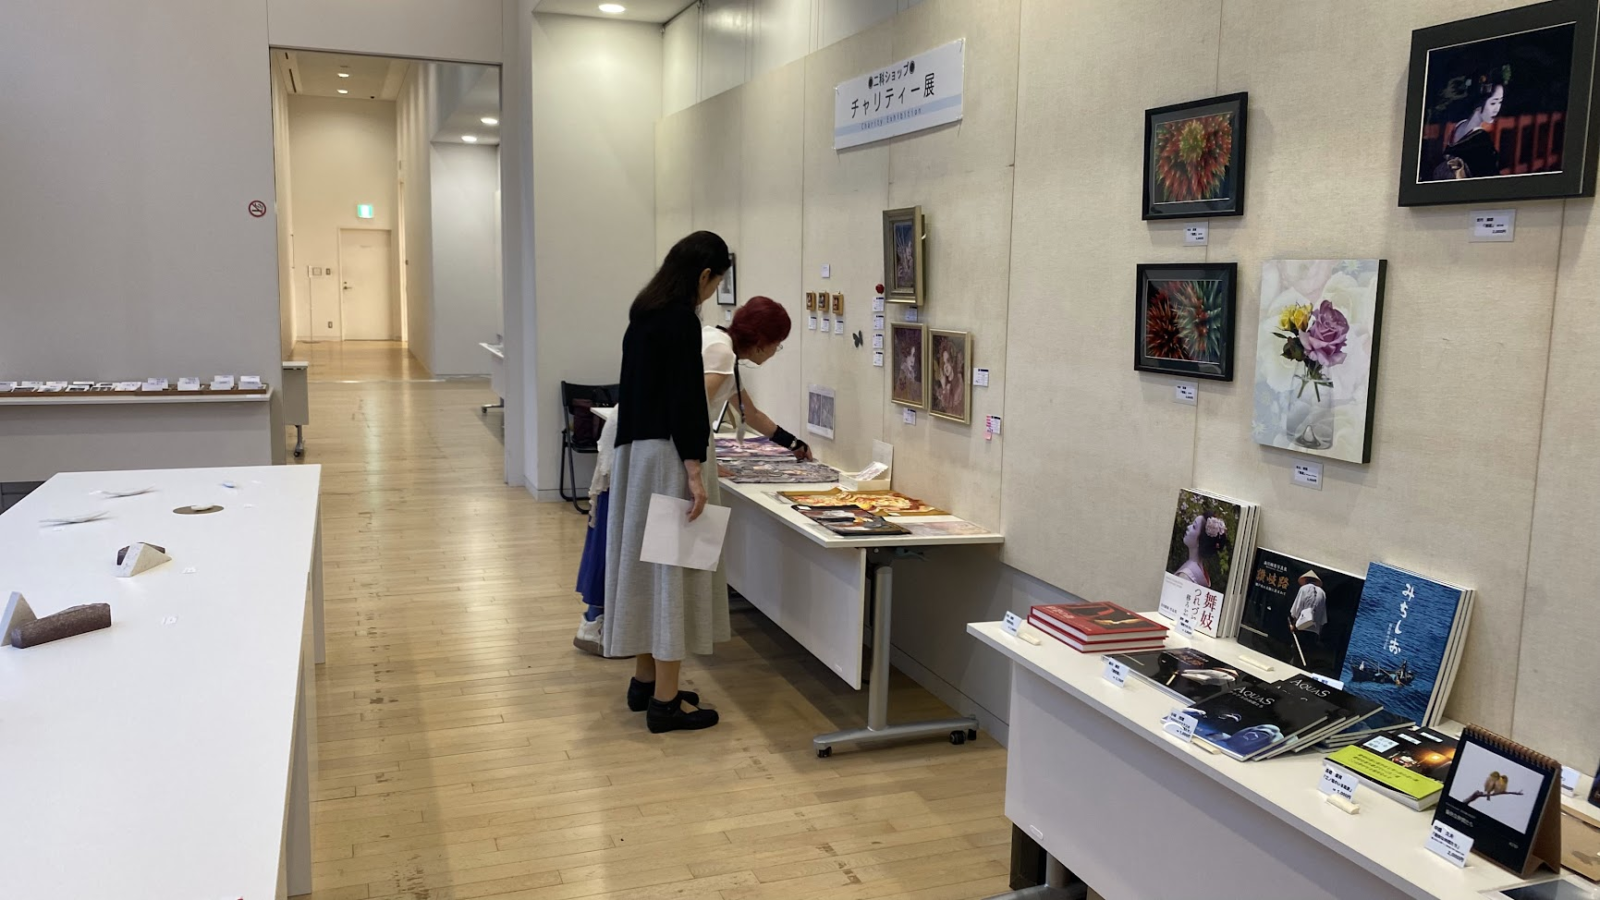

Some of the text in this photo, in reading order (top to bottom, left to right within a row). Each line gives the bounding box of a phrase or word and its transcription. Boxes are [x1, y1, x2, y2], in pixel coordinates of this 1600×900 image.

[851, 72, 935, 119] チャリティー展
[861, 107, 922, 131] Charity Exhibition
[1200, 592, 1217, 630] 舞妓
[1389, 583, 1414, 654] みちしお
[1233, 687, 1275, 706] AQUAS
[1290, 679, 1331, 698] AQUAS
